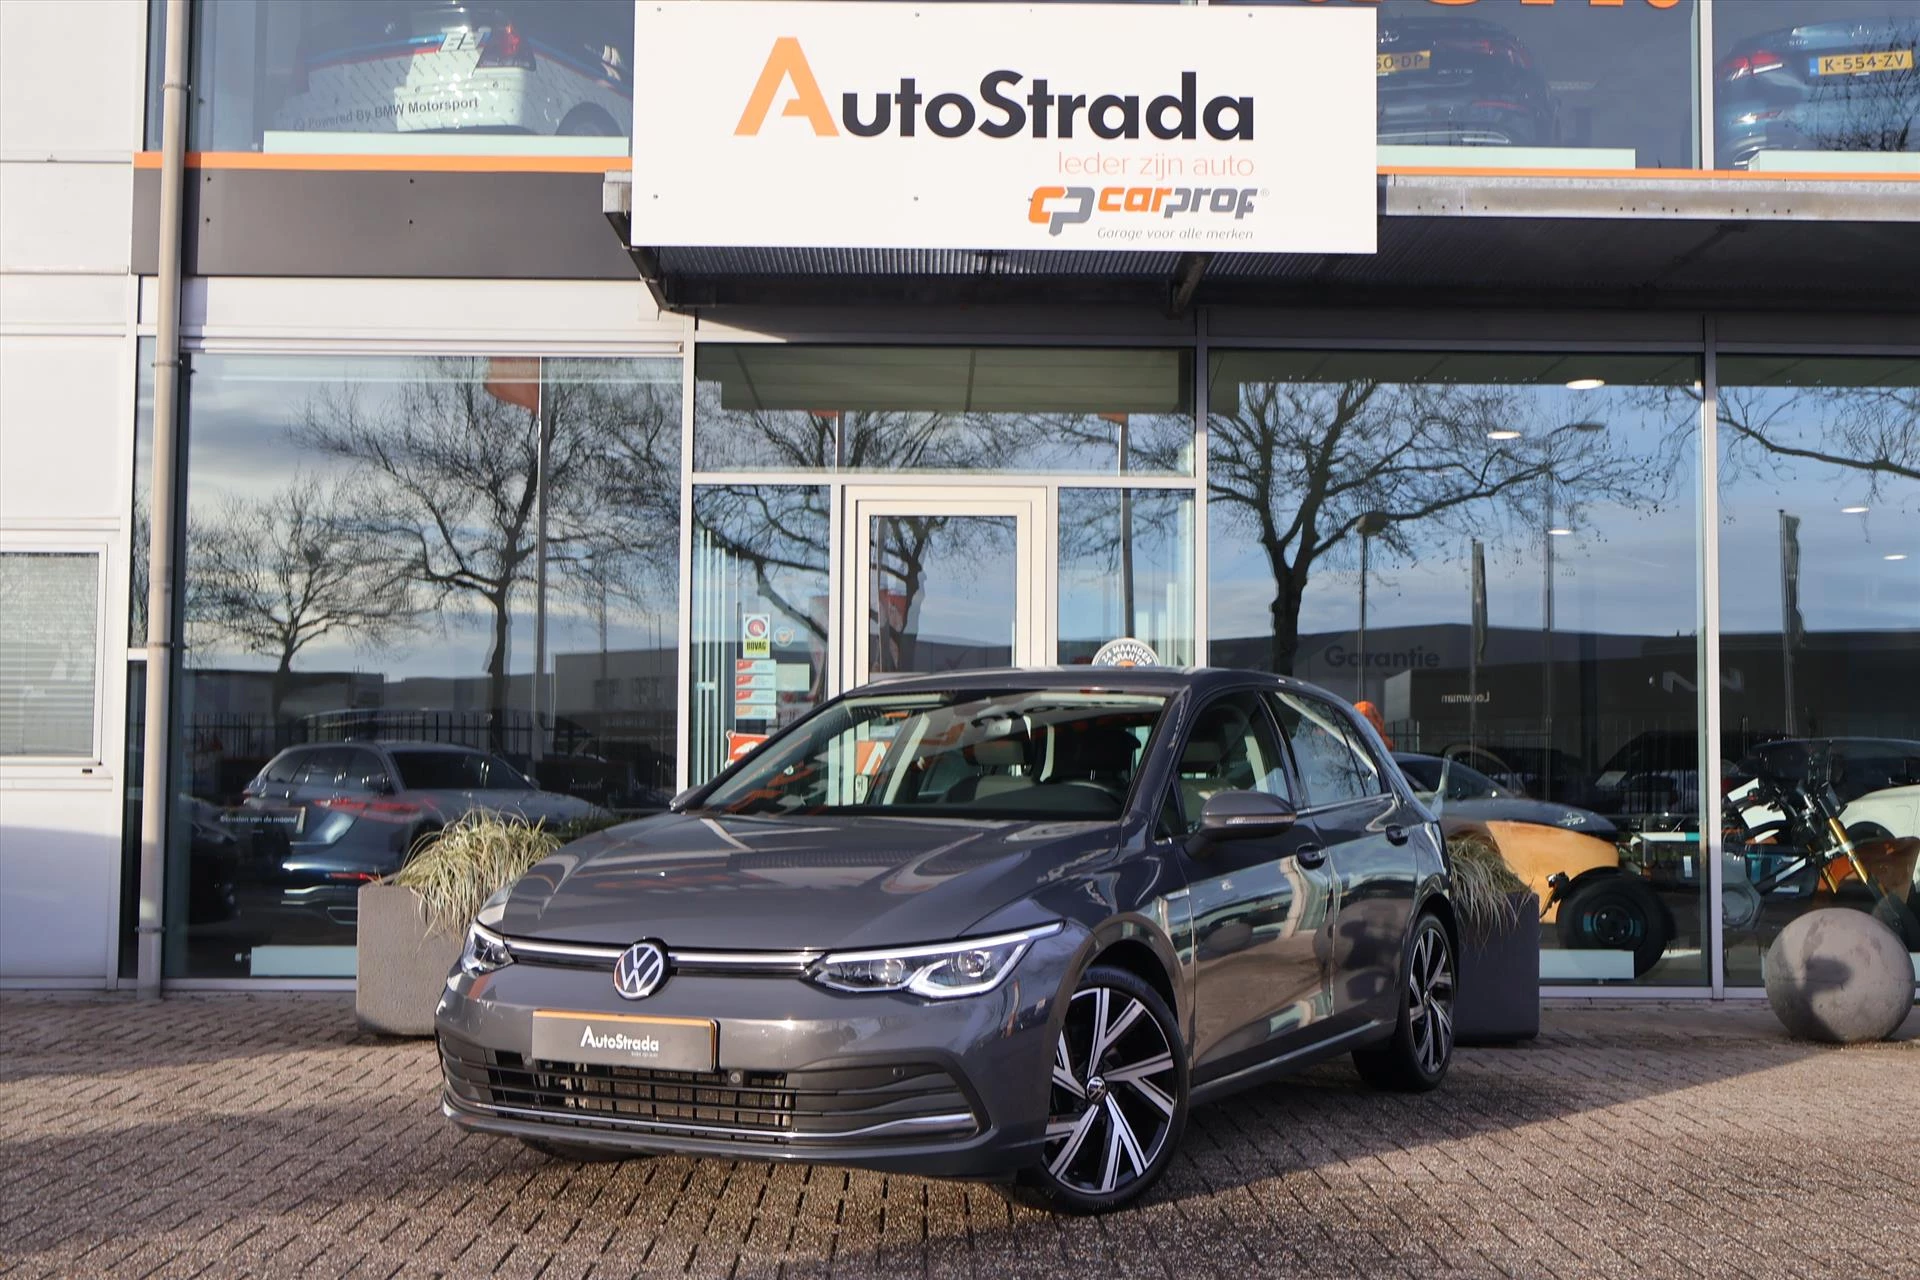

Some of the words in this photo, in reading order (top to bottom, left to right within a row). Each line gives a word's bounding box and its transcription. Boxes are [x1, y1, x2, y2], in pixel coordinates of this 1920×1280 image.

[1824, 54, 1905, 72] K-554-ZV
[733, 36, 1255, 141] AutoStrada
[308, 113, 352, 129] Powered
[356, 109, 371, 123] By
[374, 103, 405, 119] BMW
[408, 97, 479, 115] Motorsport
[1058, 151, 1131, 176] Ieder
[1139, 151, 1184, 181] zijn
[1193, 154, 1255, 177] auto
[1097, 186, 1259, 220] carprof
[1097, 226, 1143, 241] Garage
[1147, 227, 1175, 240] voor
[1179, 226, 1203, 240] alle
[1206, 226, 1254, 240] merken
[1112, 644, 1153, 664] MAANDEN
[1324, 645, 1441, 668] Garantie
[580, 1025, 659, 1052] AutoStrada
